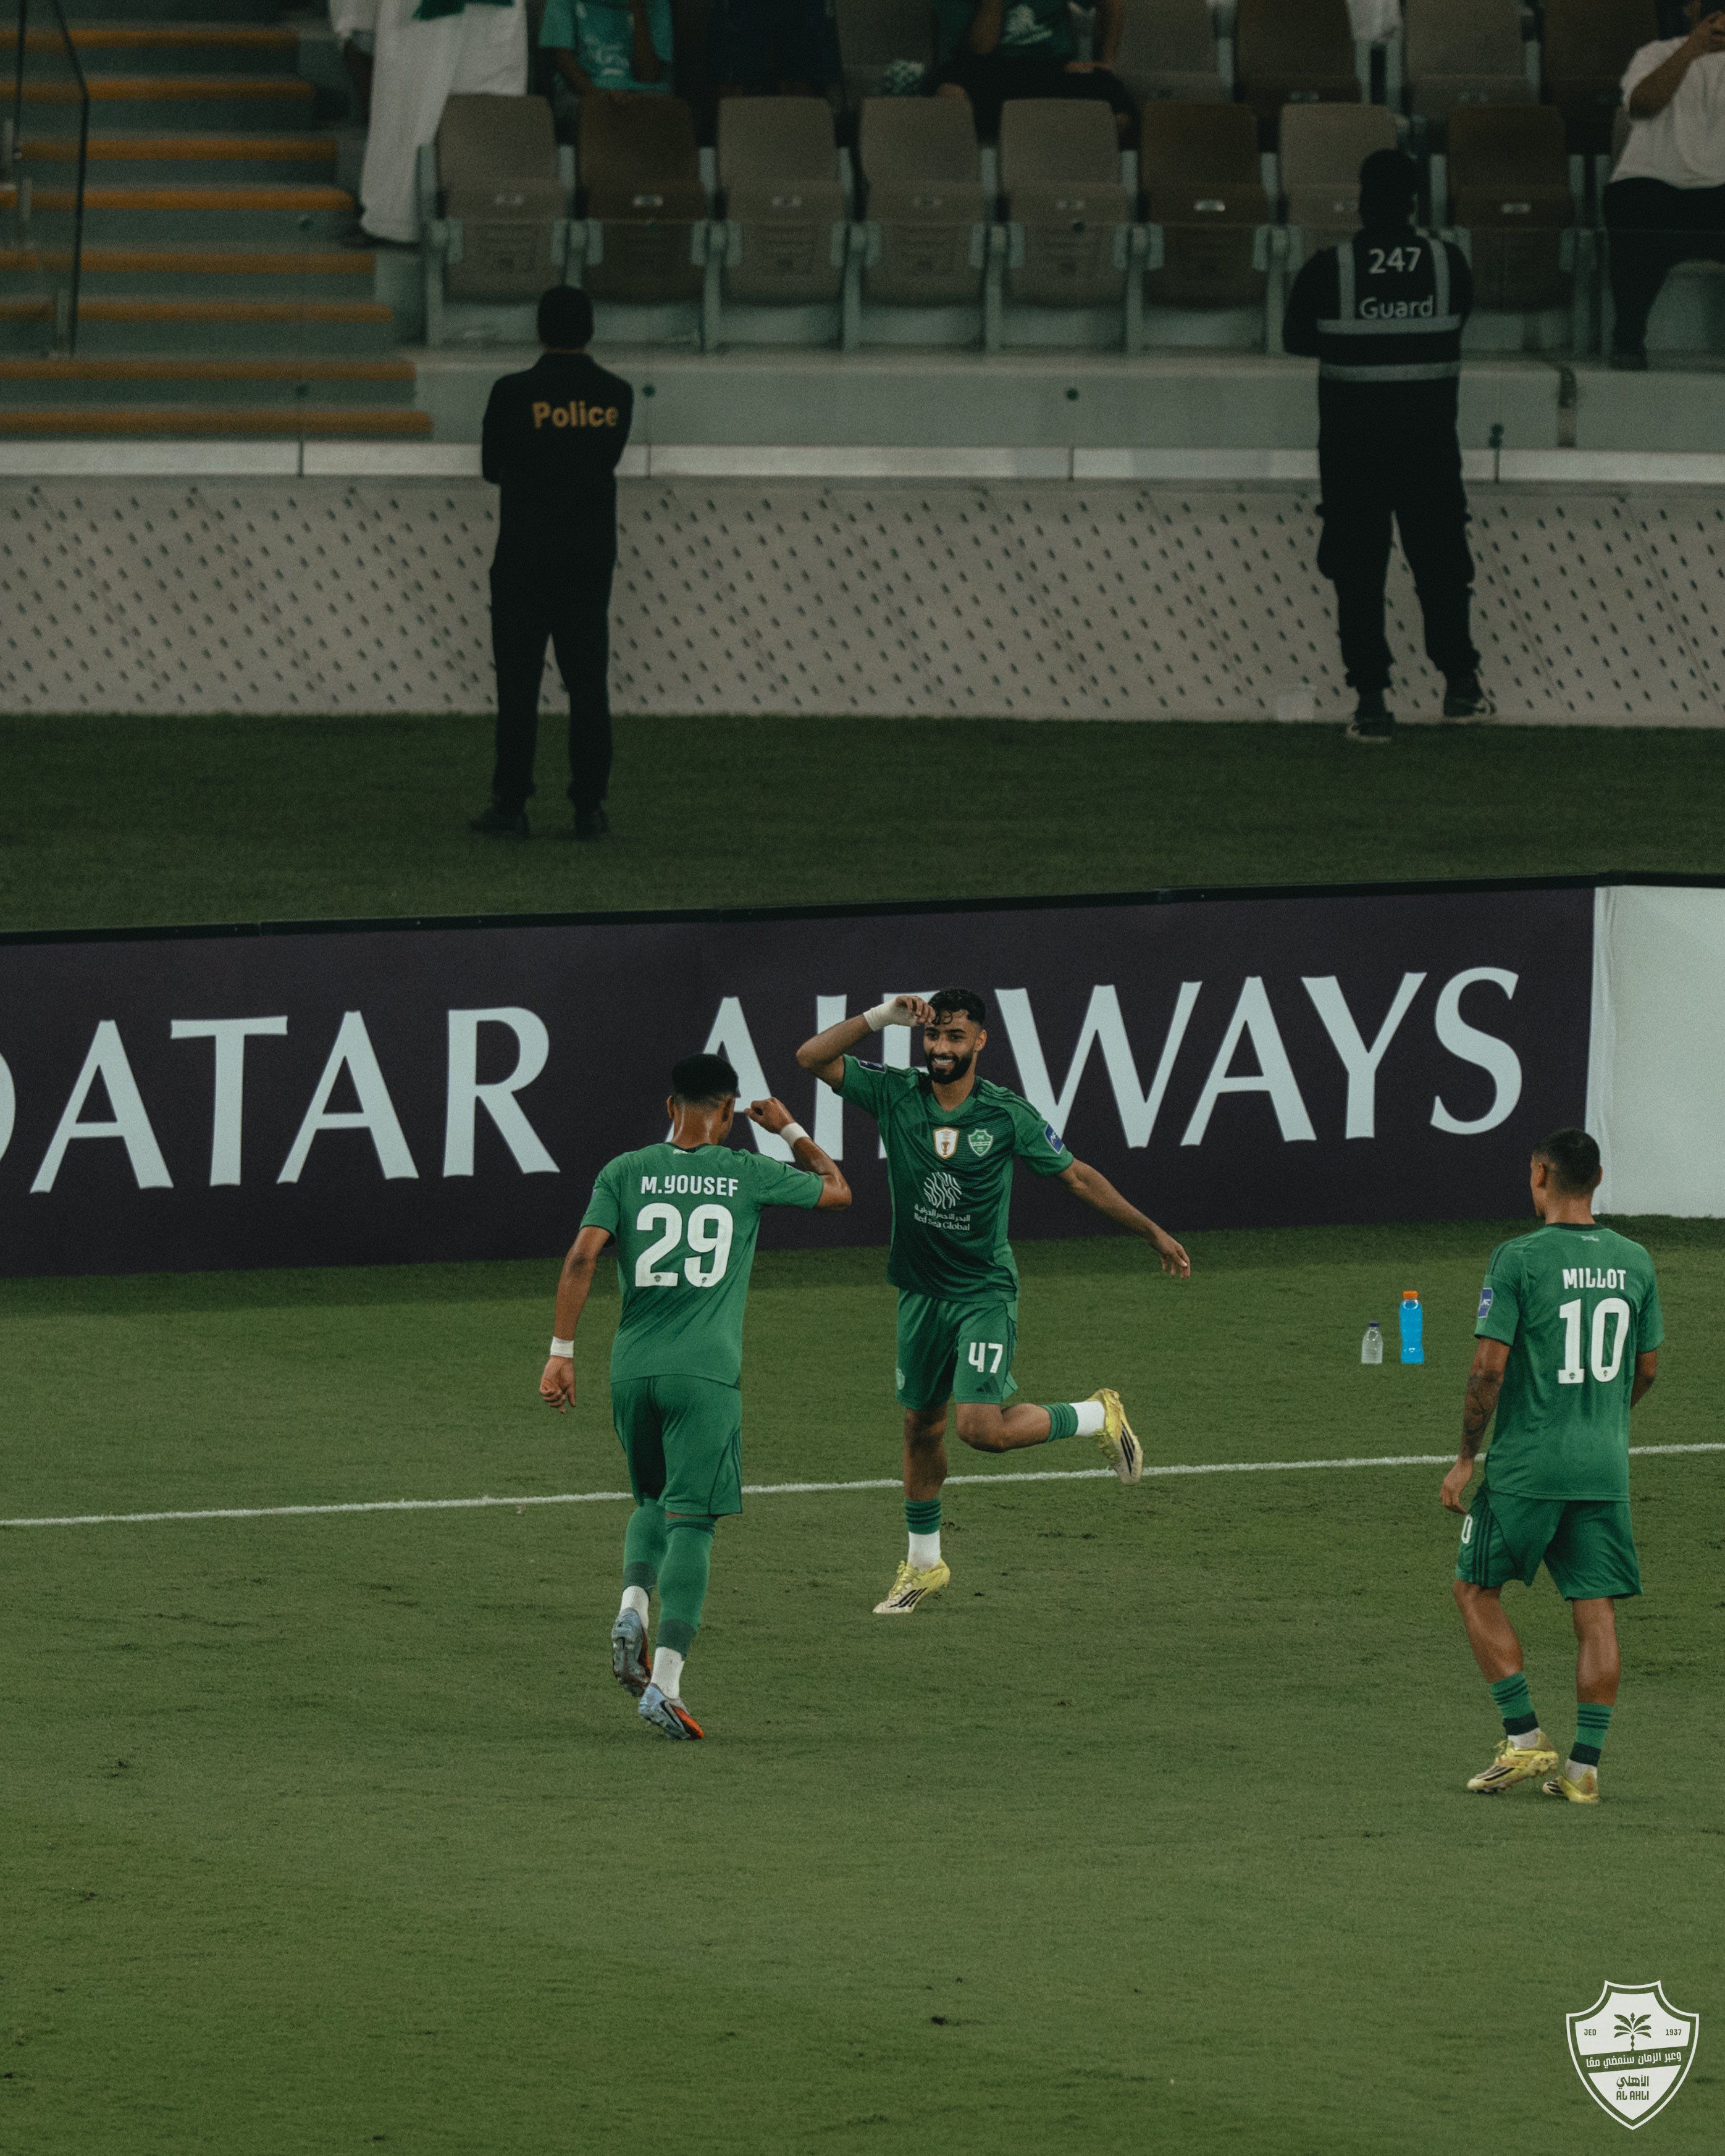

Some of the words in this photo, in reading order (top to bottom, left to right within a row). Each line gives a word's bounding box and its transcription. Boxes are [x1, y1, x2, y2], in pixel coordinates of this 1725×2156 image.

[1368, 246, 1422, 274] 247
[1359, 295, 1433, 320] Guard
[532, 401, 619, 429] Police
[0, 1006, 561, 1194] ATAR
[640, 1175, 739, 1198] M.YOUSEF
[914, 1212, 927, 1223] Red
[928, 1218, 942, 1228] Sea
[942, 1222, 970, 1231] Global
[634, 1202, 734, 1288] 29
[1562, 1268, 1627, 1290] MILLOT
[1558, 1298, 1631, 1385] 10
[968, 1341, 1004, 1374] 47
